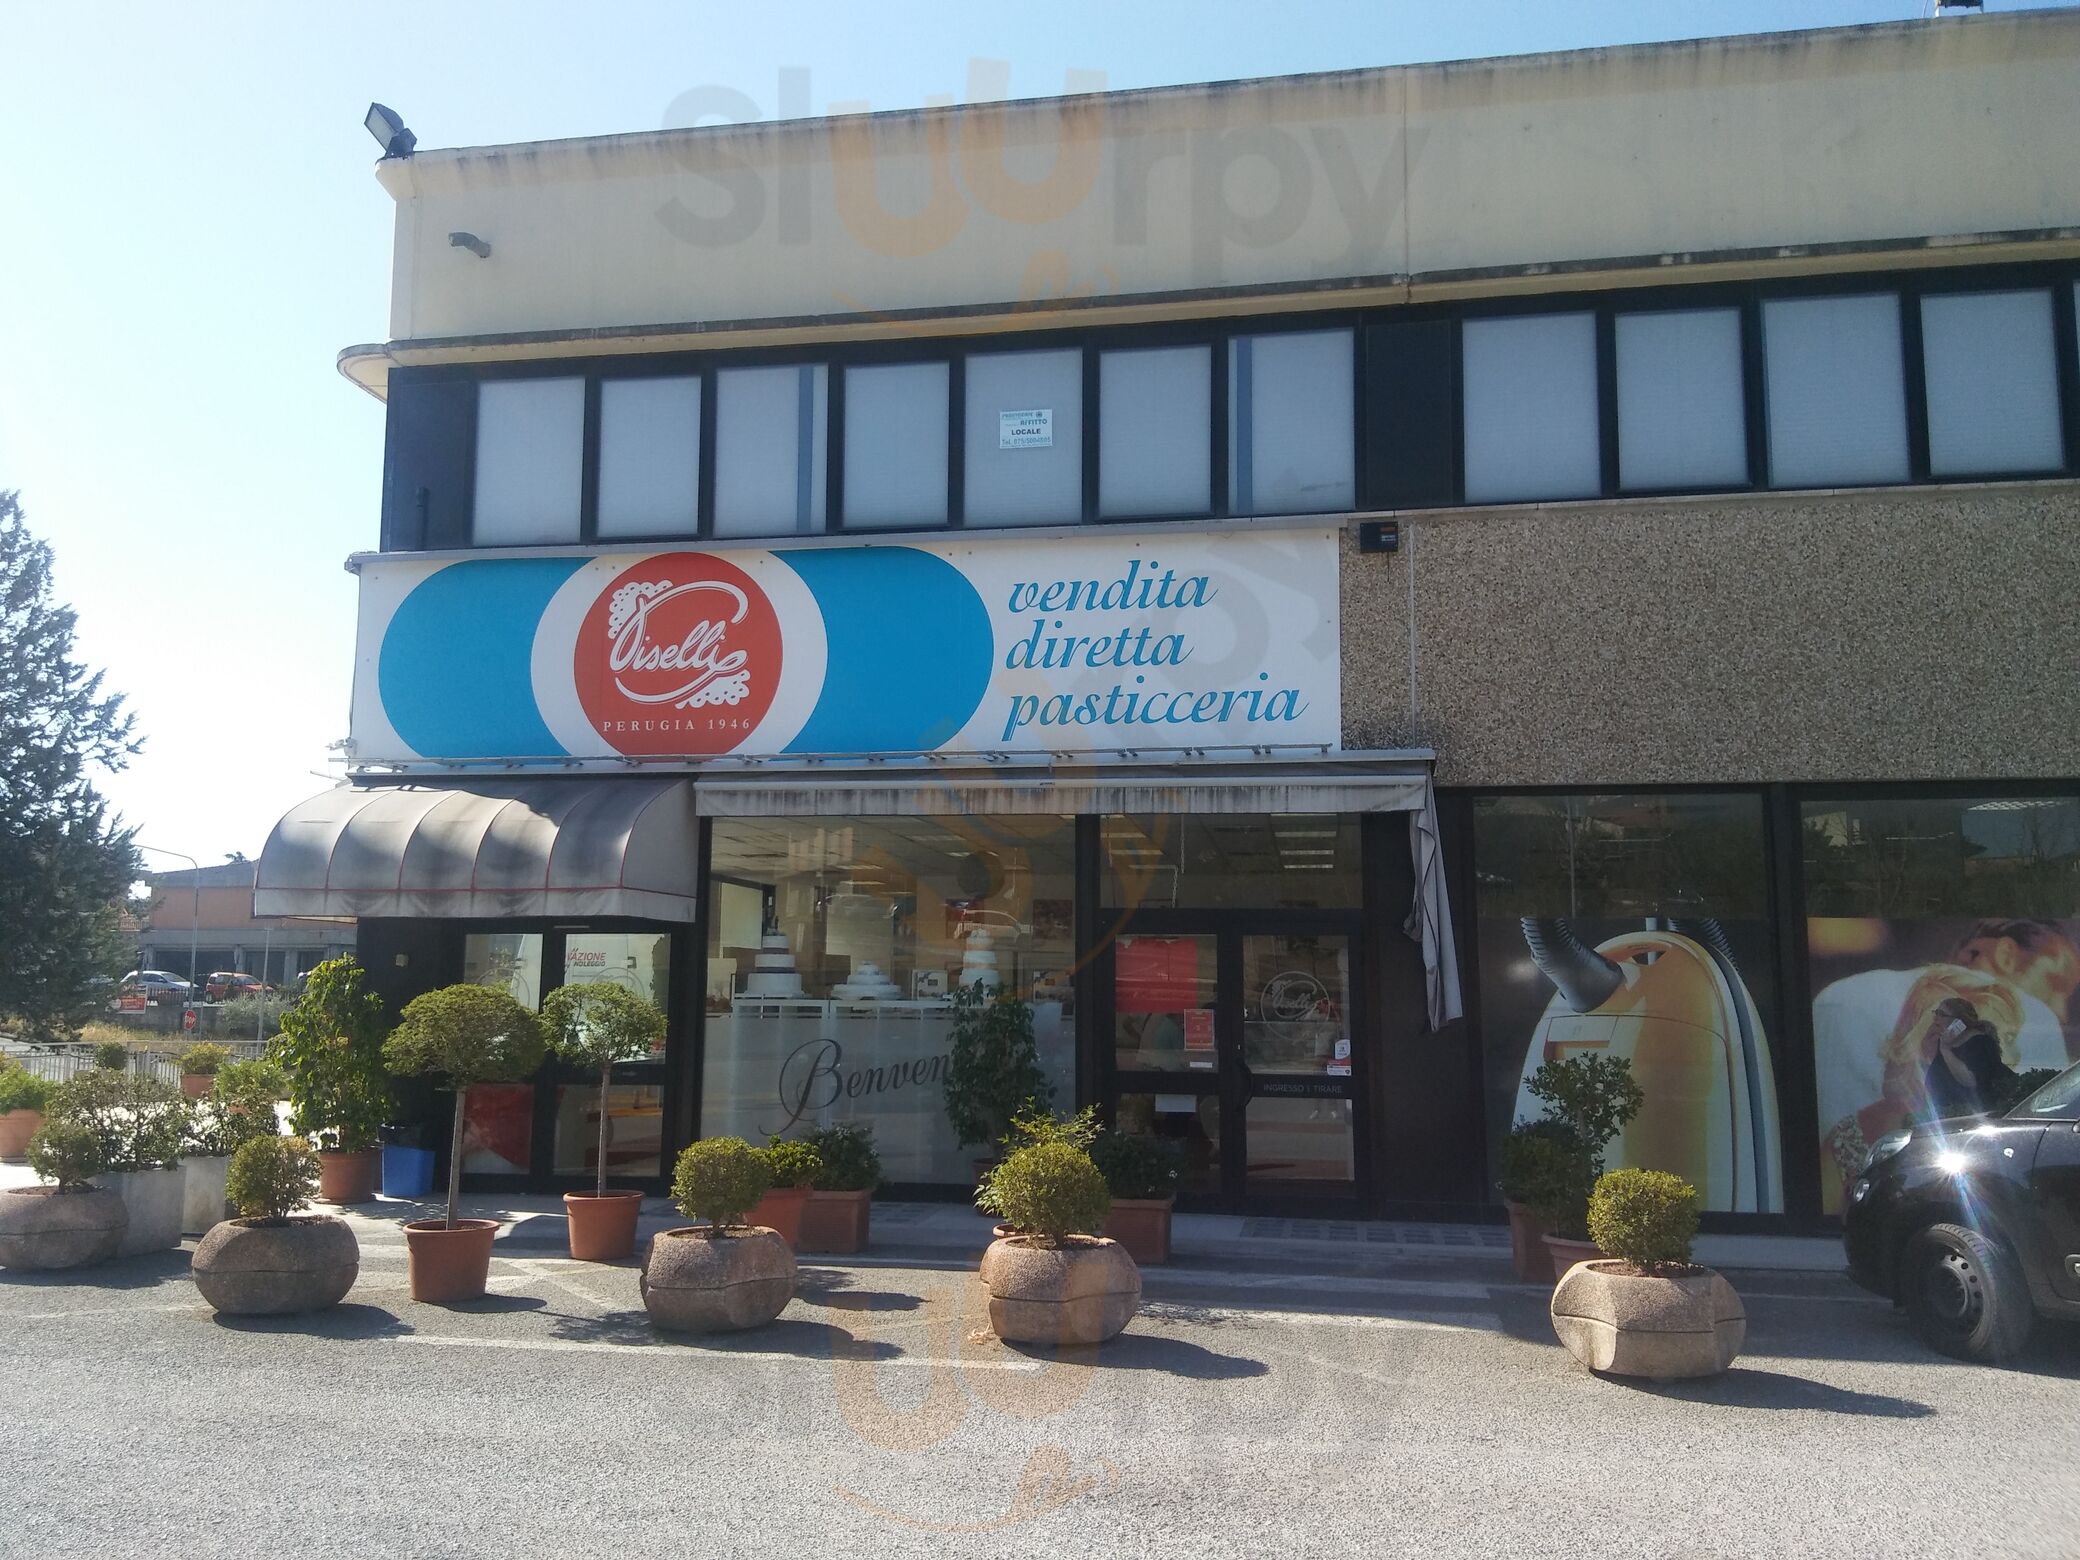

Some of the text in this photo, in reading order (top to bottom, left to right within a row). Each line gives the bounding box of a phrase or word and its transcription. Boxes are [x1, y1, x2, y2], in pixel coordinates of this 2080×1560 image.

[1011, 428, 1041, 436] LOCALE
[1008, 560, 1219, 613] vendita
[1006, 619, 1194, 669] diretta
[603, 718, 751, 732] PERUGIA 1946
[1001, 672, 1310, 741] pasticceria
[759, 1038, 953, 1136] Benven
[1263, 1083, 1343, 1094] INGRESSO TIRARE
